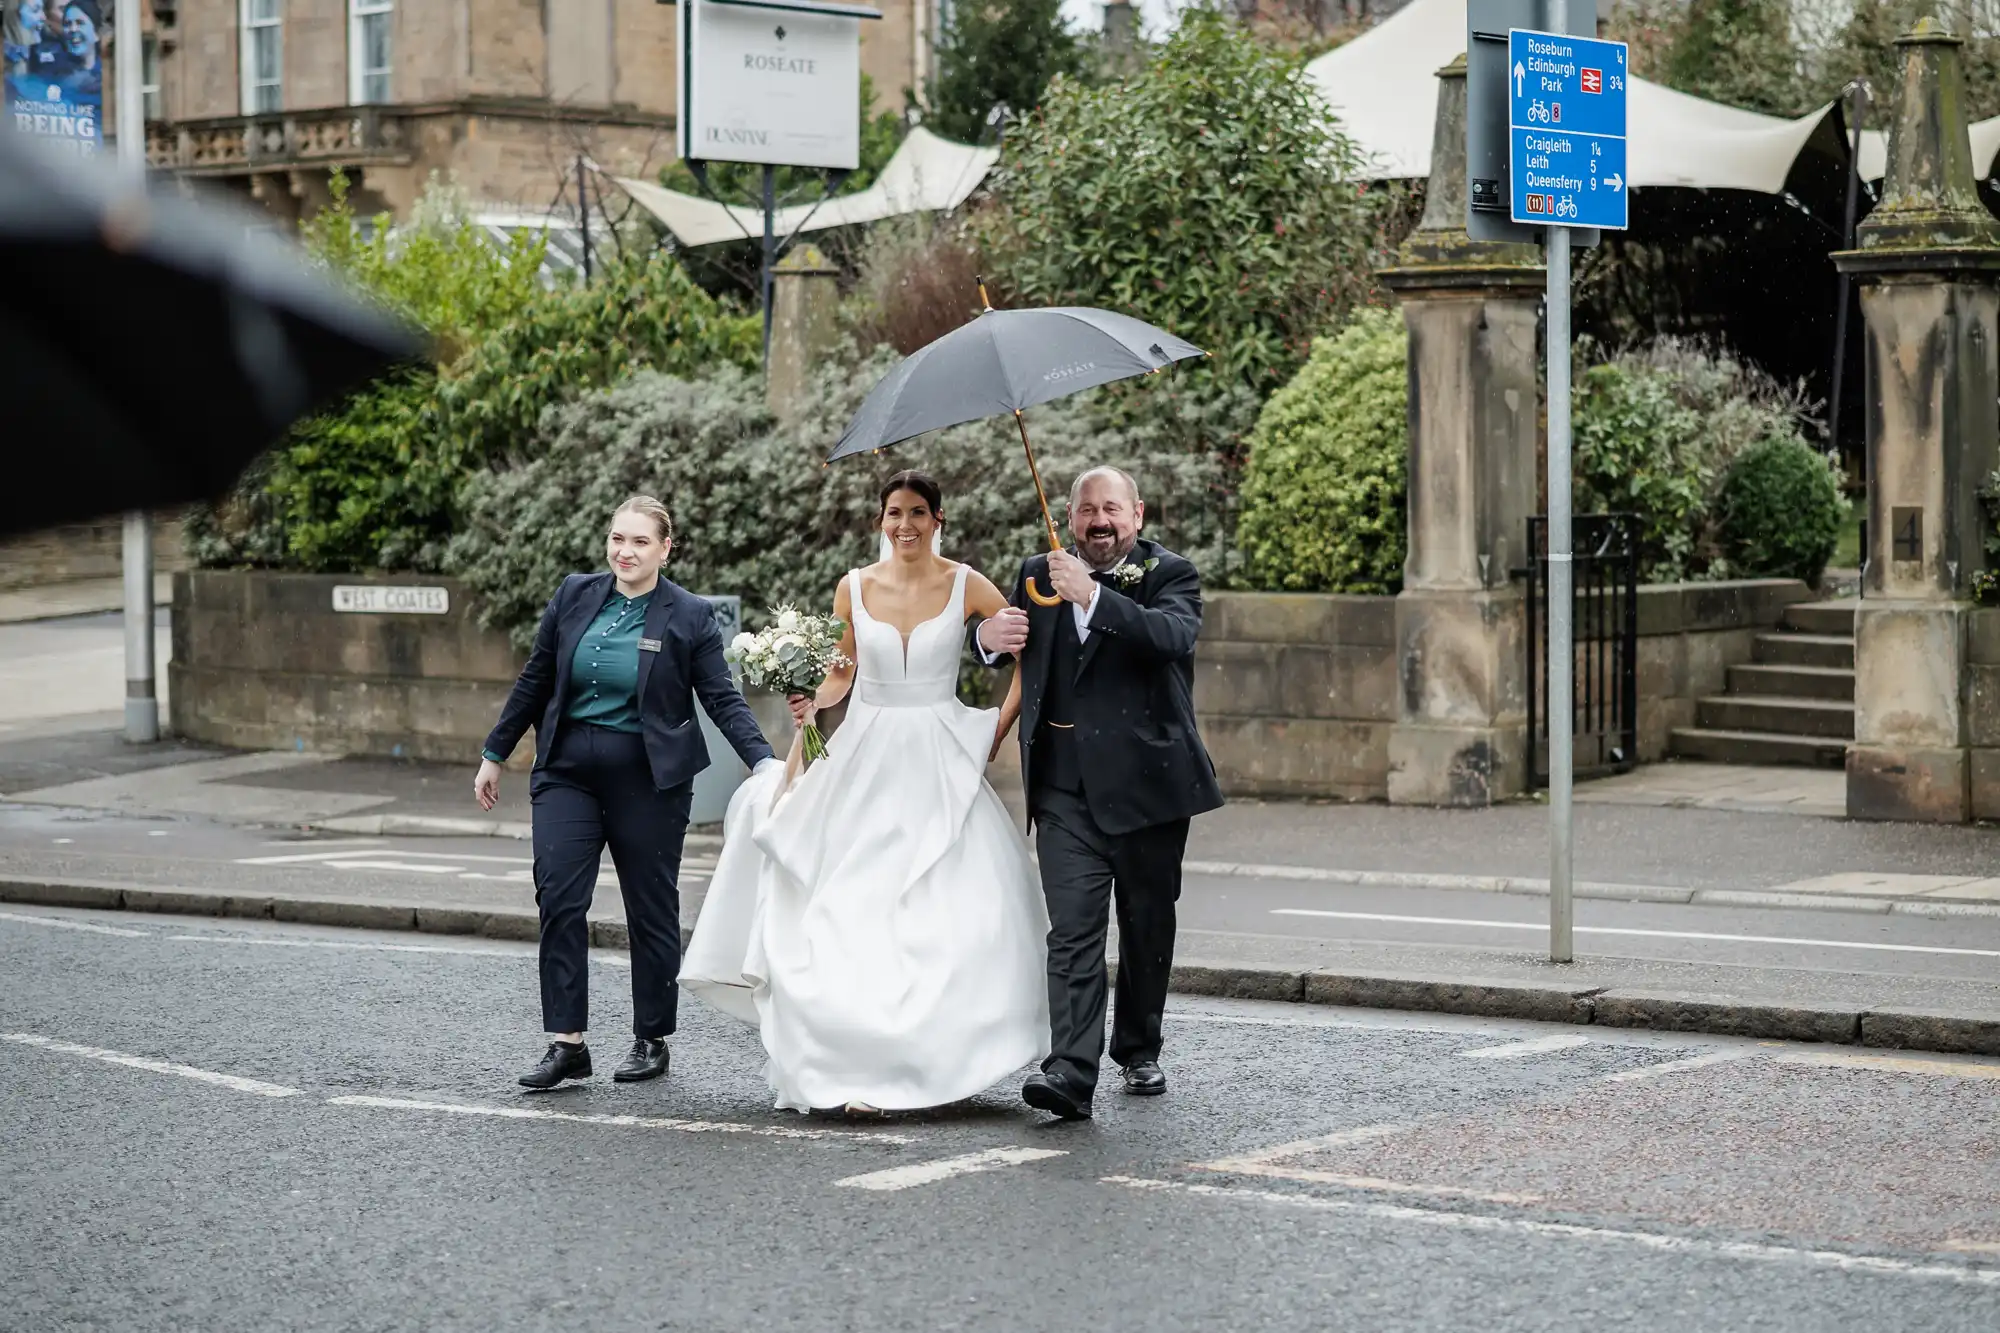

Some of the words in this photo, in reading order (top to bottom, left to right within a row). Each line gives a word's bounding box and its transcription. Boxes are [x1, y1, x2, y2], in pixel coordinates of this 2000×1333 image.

[1528, 38, 1572, 57] Roseburn
[743, 54, 817, 75] ROSEATE
[1528, 57, 1575, 77] Edinburgh
[1541, 76, 1562, 92] Park
[14, 101, 67, 114] NOTHING
[70, 104, 95, 117] LIKE
[14, 113, 95, 136] BEING
[1525, 135, 1572, 154] Craigleith
[1526, 153, 1549, 169] Leith
[1590, 159, 1597, 173] 5
[1526, 171, 1583, 192] Queensferry
[1590, 177, 1597, 191] 9
[1043, 361, 1096, 381] ROSEATE
[1894, 511, 1921, 556] 4
[341, 590, 376, 608] WEST
[384, 590, 442, 609] COATES
